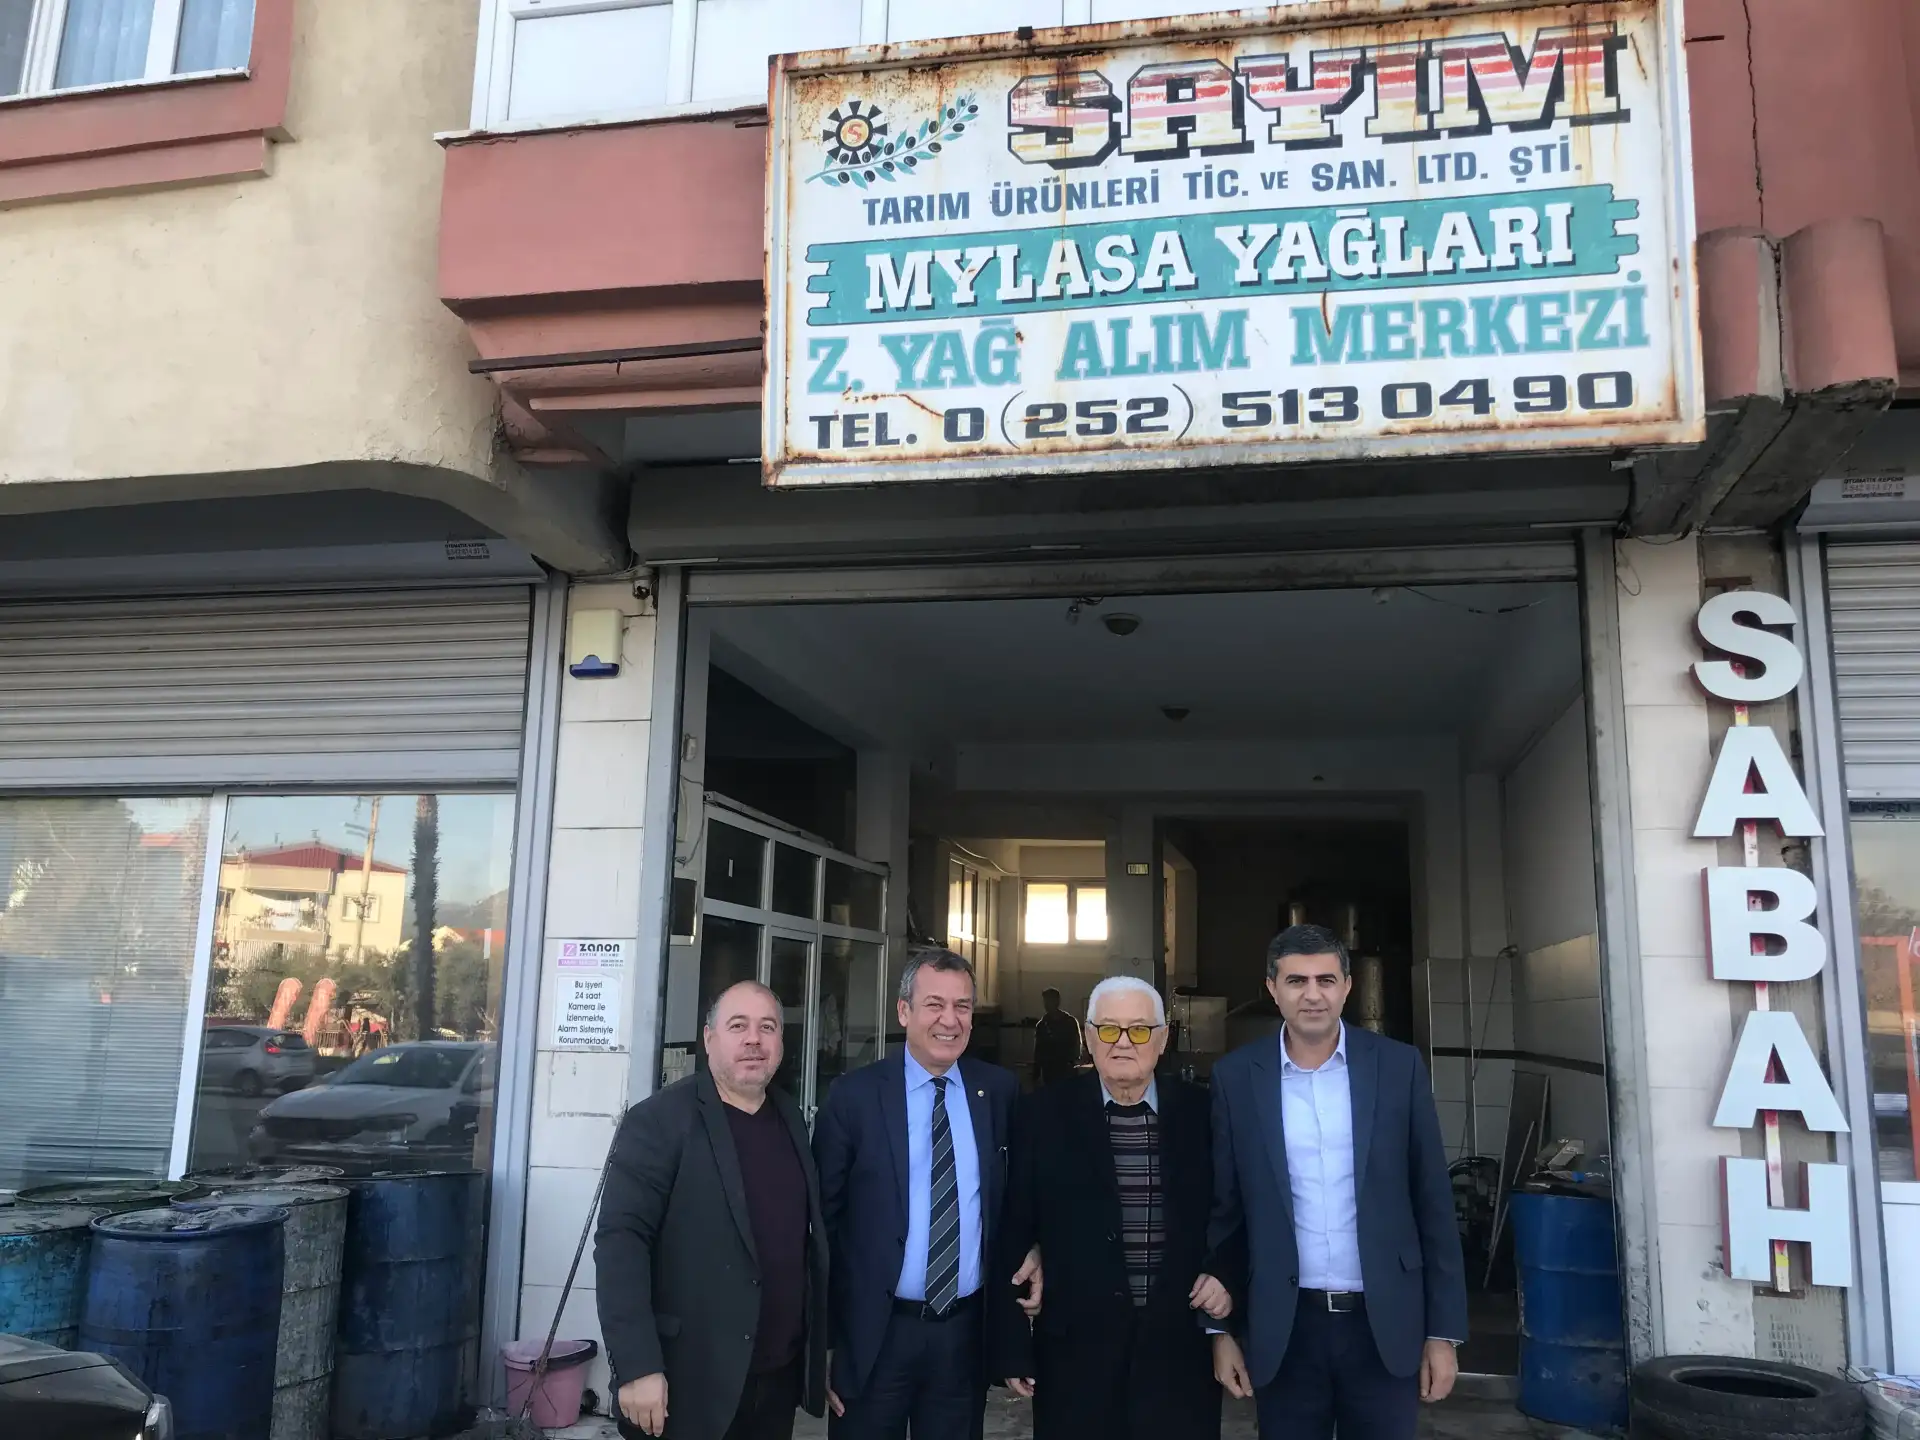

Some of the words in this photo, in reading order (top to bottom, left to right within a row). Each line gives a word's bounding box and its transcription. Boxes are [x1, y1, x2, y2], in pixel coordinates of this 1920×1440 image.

[1007, 21, 1630, 170] SAYIM
[862, 191, 970, 226] TARIM
[990, 168, 1160, 217] ÜRÜNLERİ
[1183, 163, 1249, 199] TİC.
[1260, 171, 1289, 191] VE
[1311, 157, 1398, 192] SAN.
[1417, 149, 1489, 185] LTD.
[1509, 135, 1583, 184] ŞTİ.
[864, 230, 1198, 314] MYLASA
[1214, 202, 1578, 287] YAĞLARI
[806, 336, 865, 394] Z.
[878, 317, 1023, 390] YAĞ
[1056, 307, 1251, 382] ALIM
[1290, 269, 1651, 366] MERKEZİ
[808, 411, 918, 451] TEL.
[579, 943, 620, 953] zanon
[1690, 590, 1852, 1288] SABAH
[574, 980, 584, 989] Bu
[585, 980, 603, 990] işyeri
[575, 991, 584, 1000] 24
[585, 991, 602, 1000] saat
[568, 1002, 595, 1011] Kamera
[597, 1002, 606, 1011] ile
[557, 1024, 578, 1033] Alarm
[579, 1024, 614, 1035] Sistemiyle
[558, 1035, 611, 1046] Korunmaktadır.
